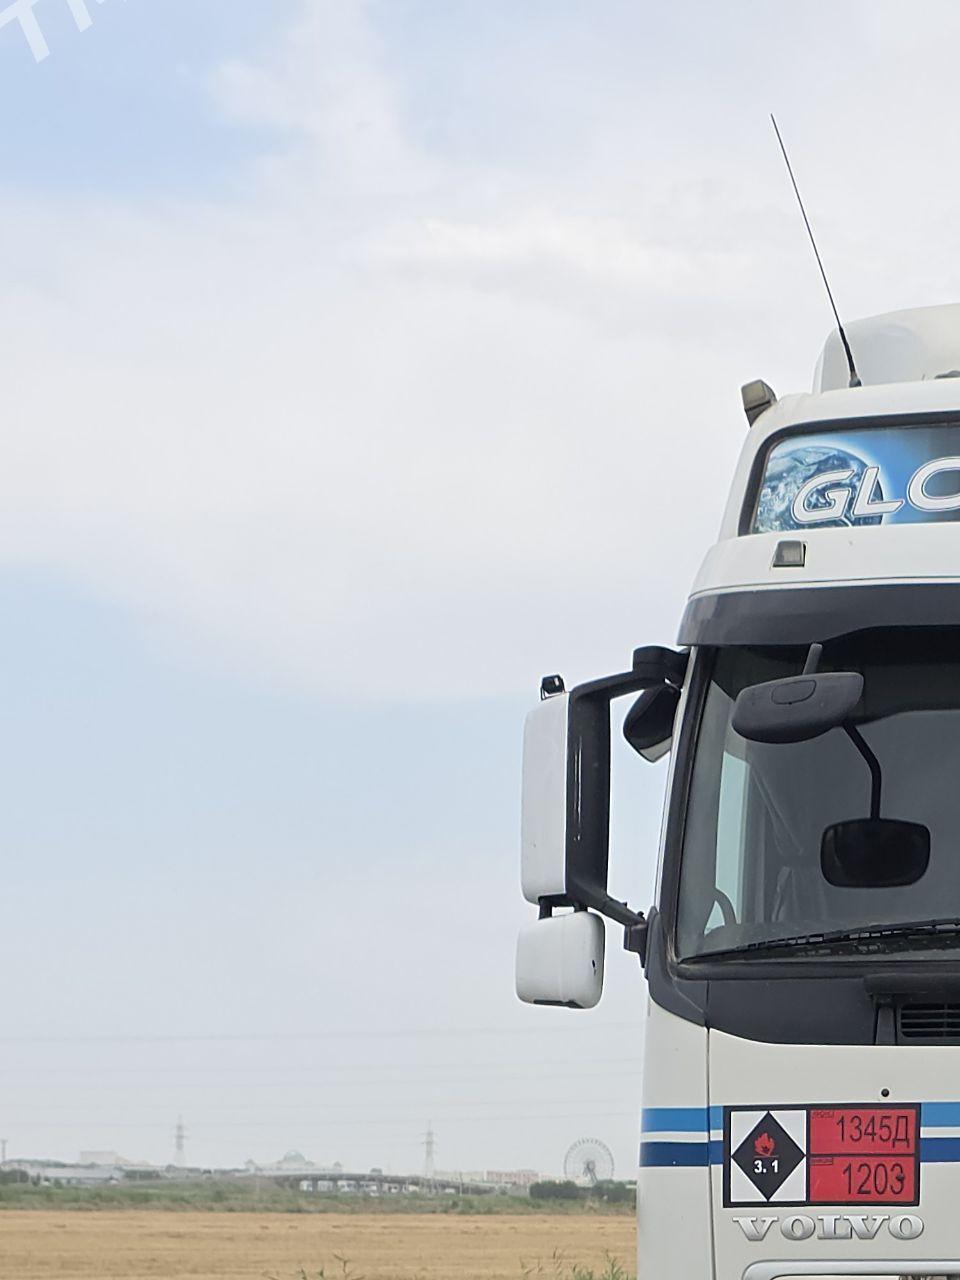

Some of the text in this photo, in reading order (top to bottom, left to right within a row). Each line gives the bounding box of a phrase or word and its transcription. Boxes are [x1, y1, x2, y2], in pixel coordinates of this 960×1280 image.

[836, 1114, 910, 1148] 1345Д
[843, 1162, 906, 1195] 1203
[732, 1213, 925, 1242] VOLVO
